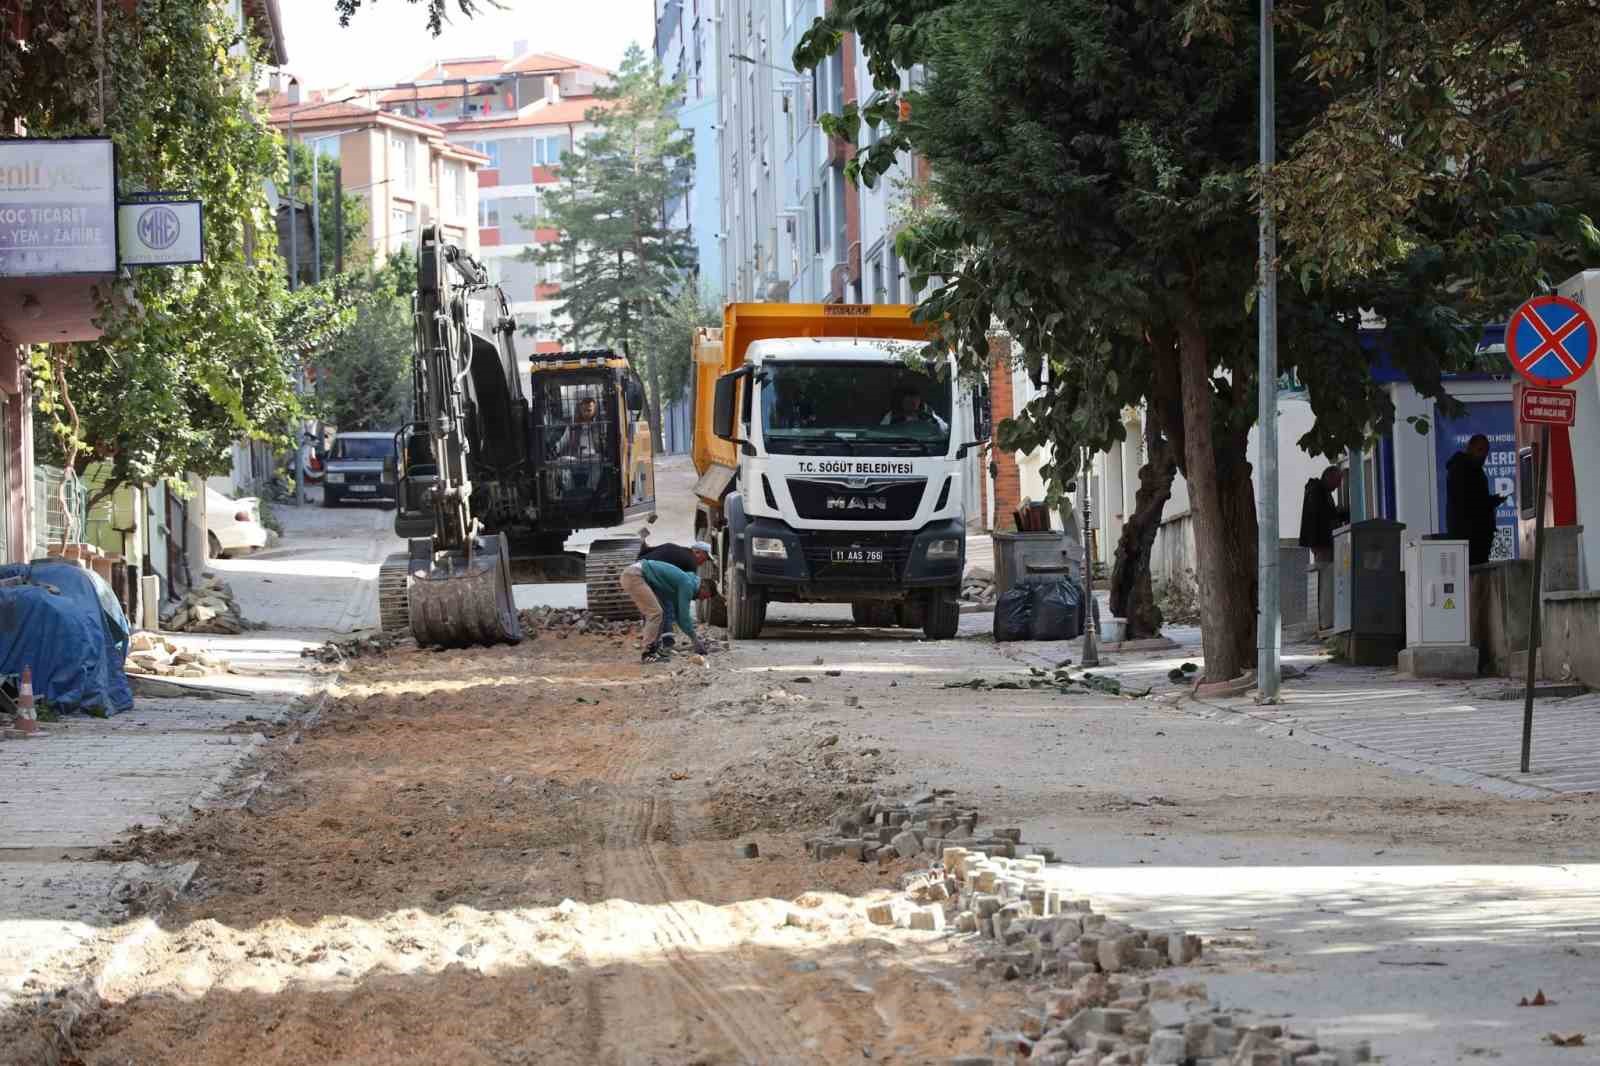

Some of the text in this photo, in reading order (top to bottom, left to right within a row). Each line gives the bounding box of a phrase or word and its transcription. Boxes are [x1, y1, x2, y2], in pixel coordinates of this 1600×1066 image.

[799, 461, 913, 474] T.C. SÖĞÜT BELEDİYESİ
[826, 496, 887, 510] MAN
[836, 551, 844, 560] 11
[848, 551, 863, 560] AAS
